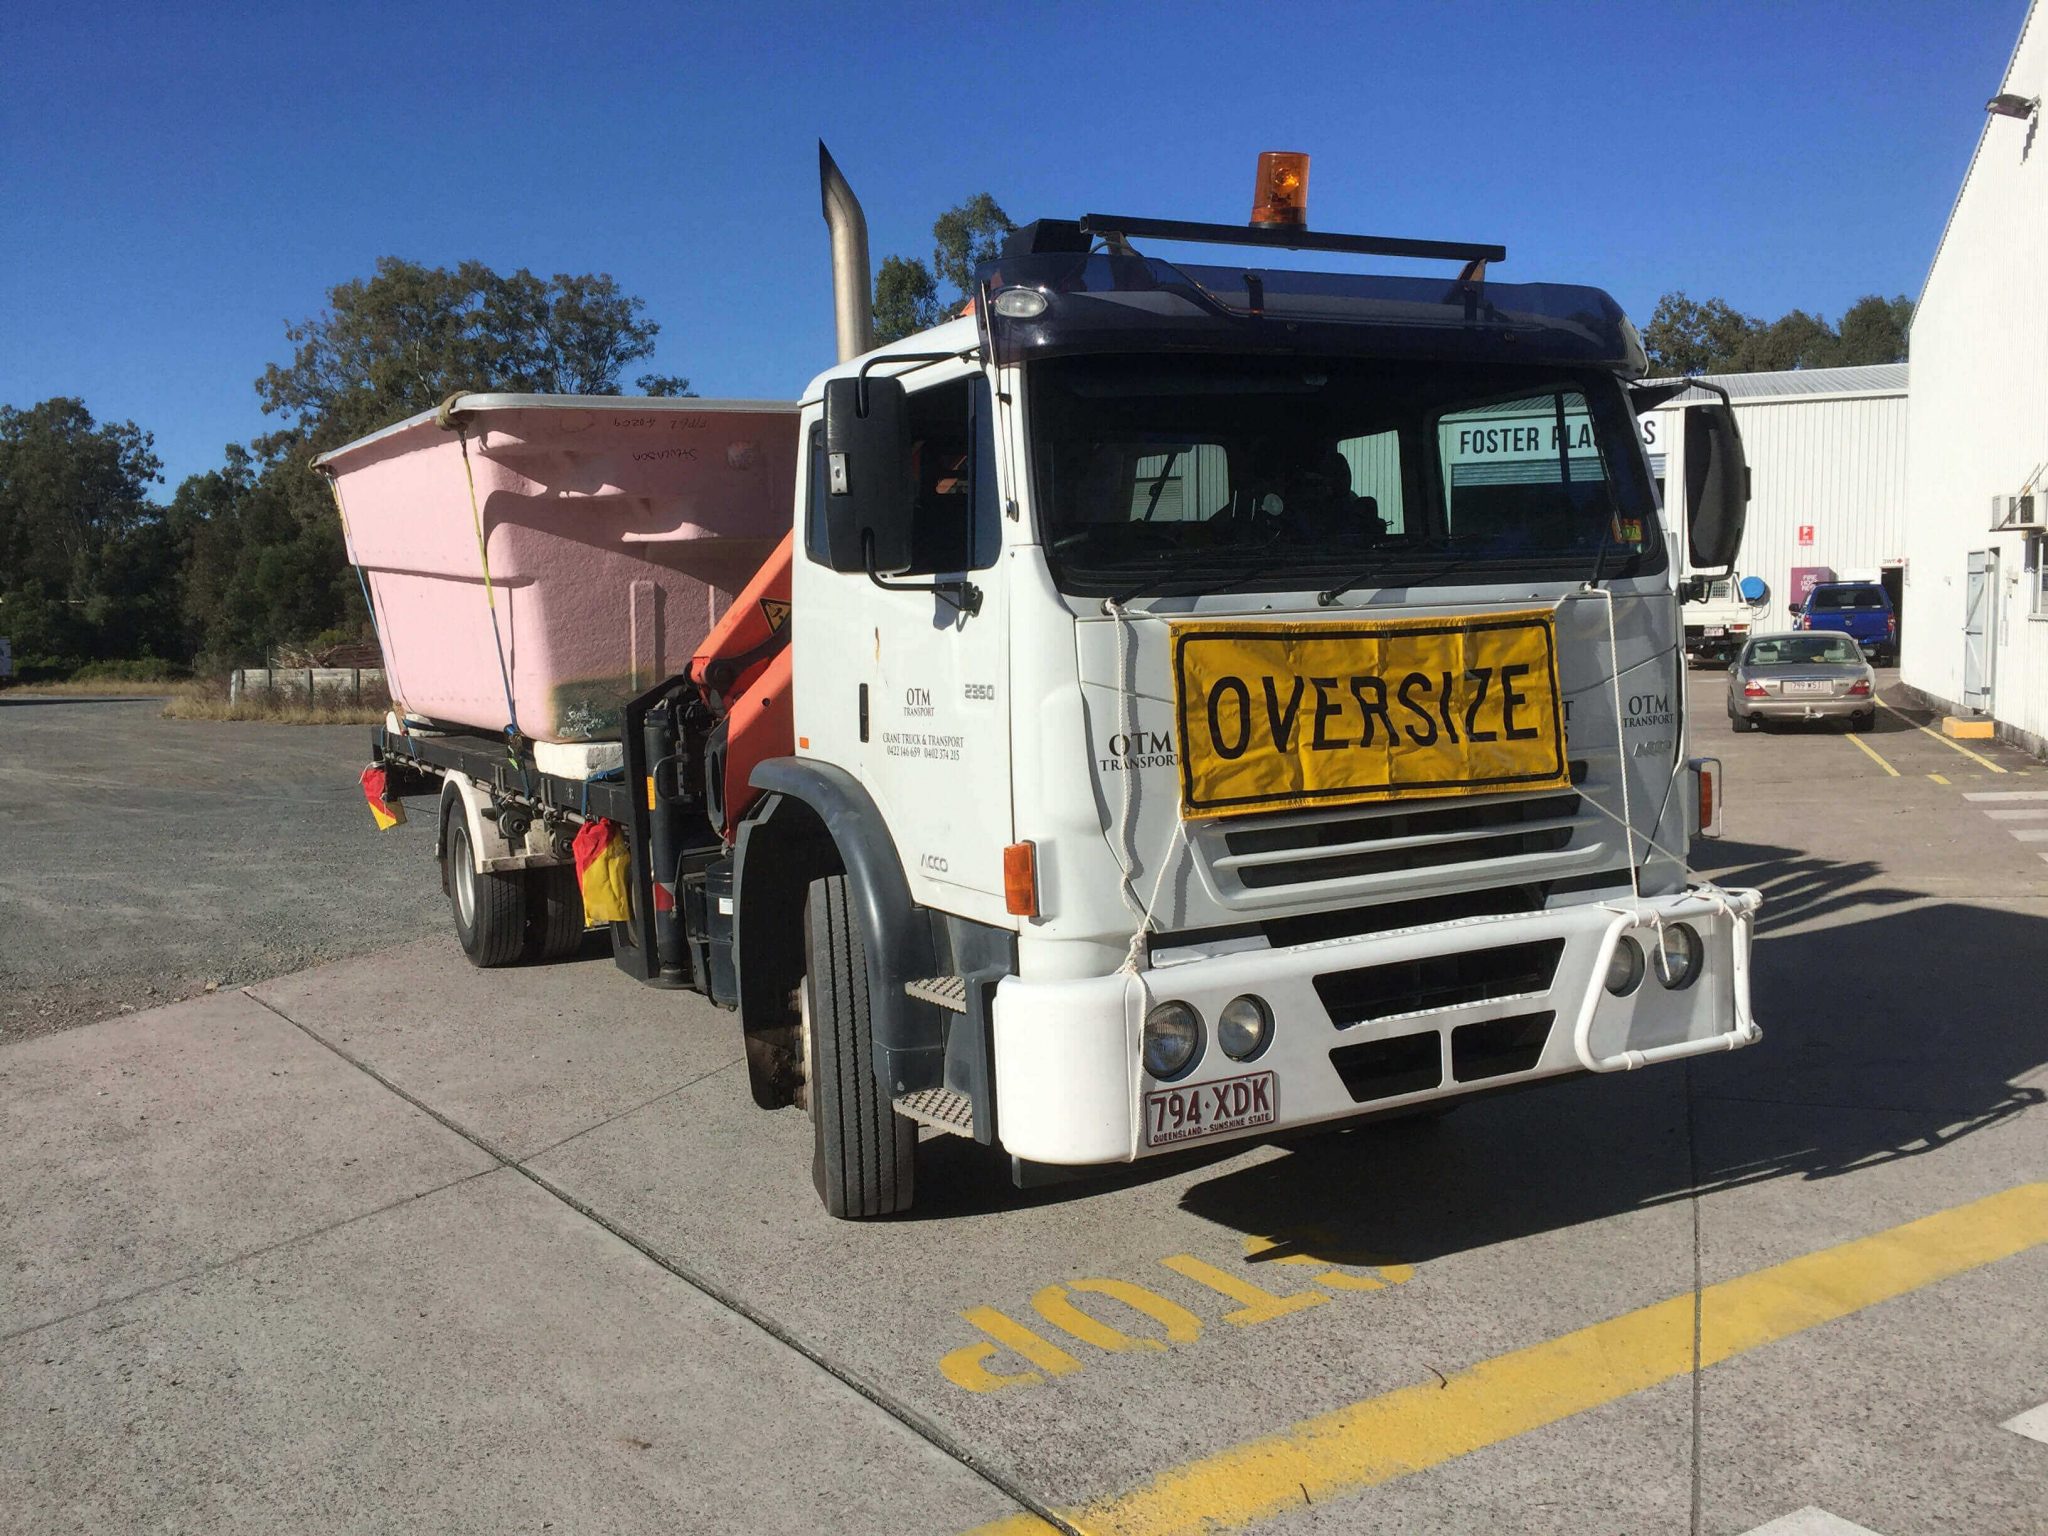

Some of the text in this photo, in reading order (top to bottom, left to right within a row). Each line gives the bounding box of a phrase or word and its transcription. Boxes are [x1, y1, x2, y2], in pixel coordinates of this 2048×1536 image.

[1460, 420, 1656, 454] FOSTER PLAS
[906, 688, 931, 706] OTM
[1628, 694, 1669, 716] OTM
[904, 707, 935, 717] TRANSPORT
[1207, 663, 1538, 760] OVERSIZE
[1623, 714, 1673, 728] TRANSPORT
[883, 732, 964, 748] CRANE TRUCK & TRANSPORT
[1109, 730, 1173, 756] OTM
[921, 854, 948, 873] ACCO
[1153, 1126, 1202, 1143] QUEENSLAND
[1210, 1117, 1245, 1132] SUNSHINE
[1248, 1113, 1270, 1124] STATE
